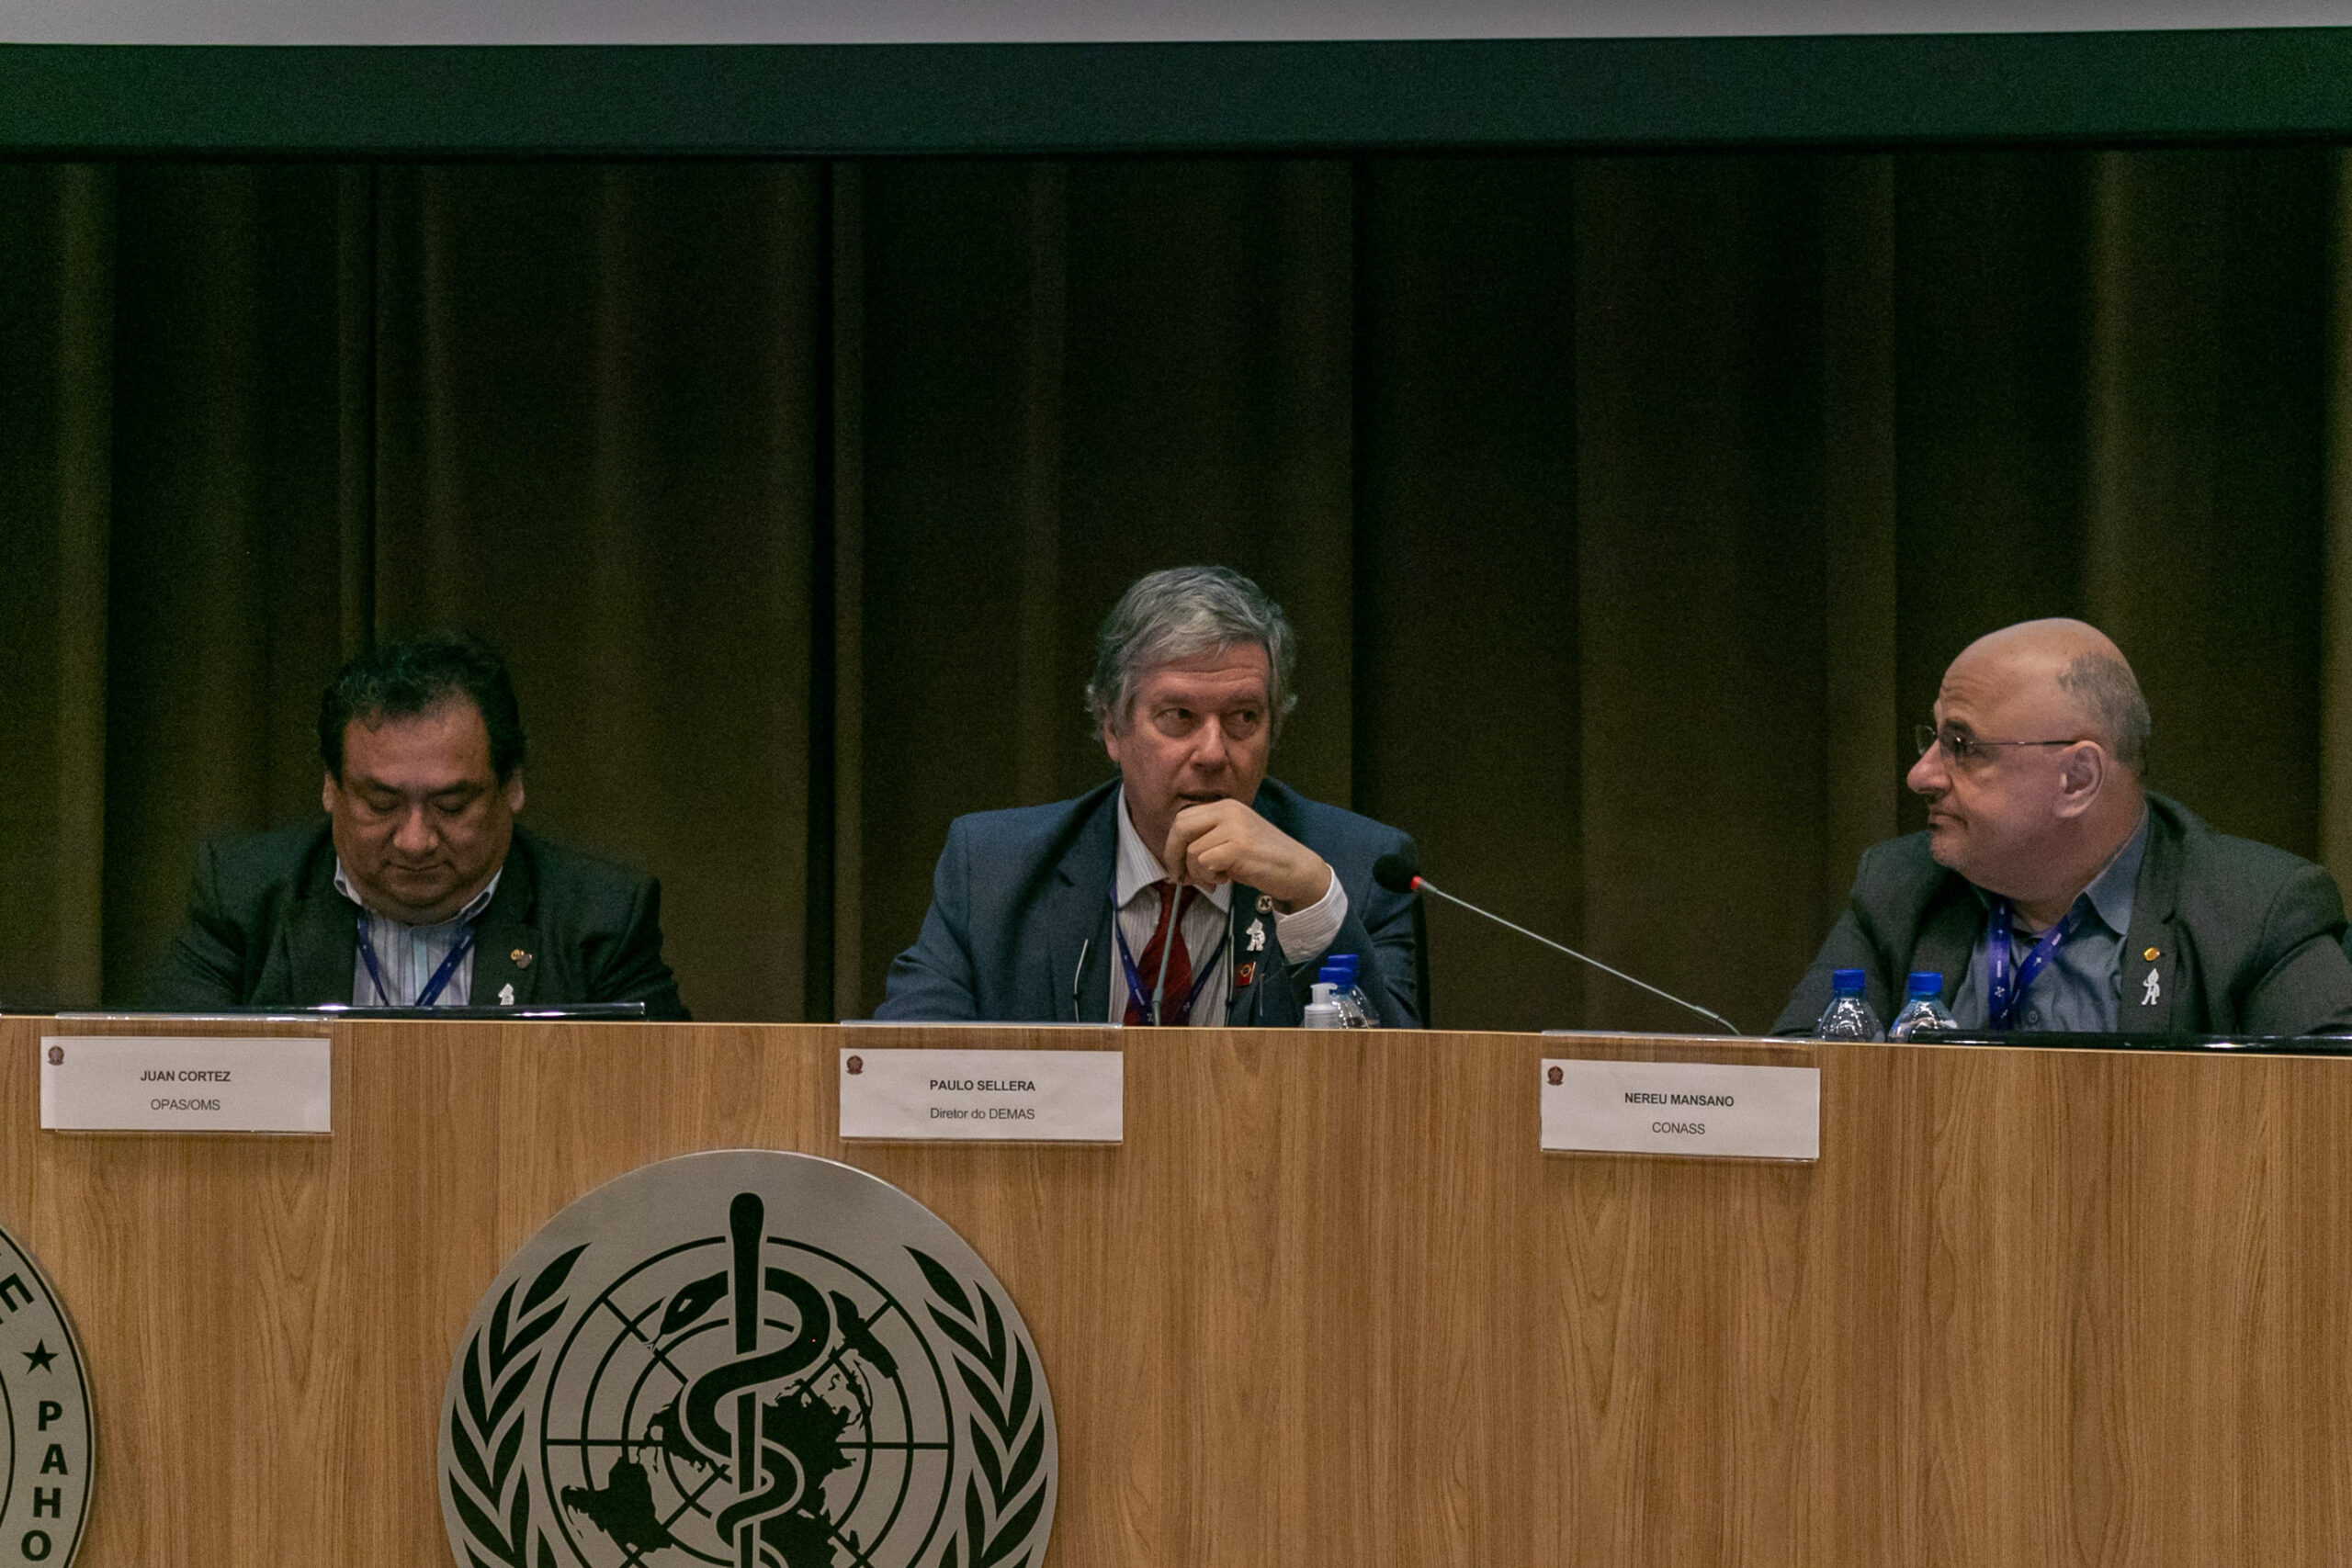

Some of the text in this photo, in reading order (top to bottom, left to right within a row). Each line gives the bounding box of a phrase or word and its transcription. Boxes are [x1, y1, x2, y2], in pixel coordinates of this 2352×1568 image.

[140, 1070, 232, 1082] JUAN CORTEZ
[929, 1079, 1036, 1092] PAULO SELLERA
[150, 1098, 221, 1111] OPAS/OMS
[1624, 1091, 1735, 1108] NEREU MANSANO
[930, 1107, 1035, 1120] Diretor do DEMAS
[1652, 1122, 1706, 1135] CONASS
[20, 1400, 70, 1562] PAHO
